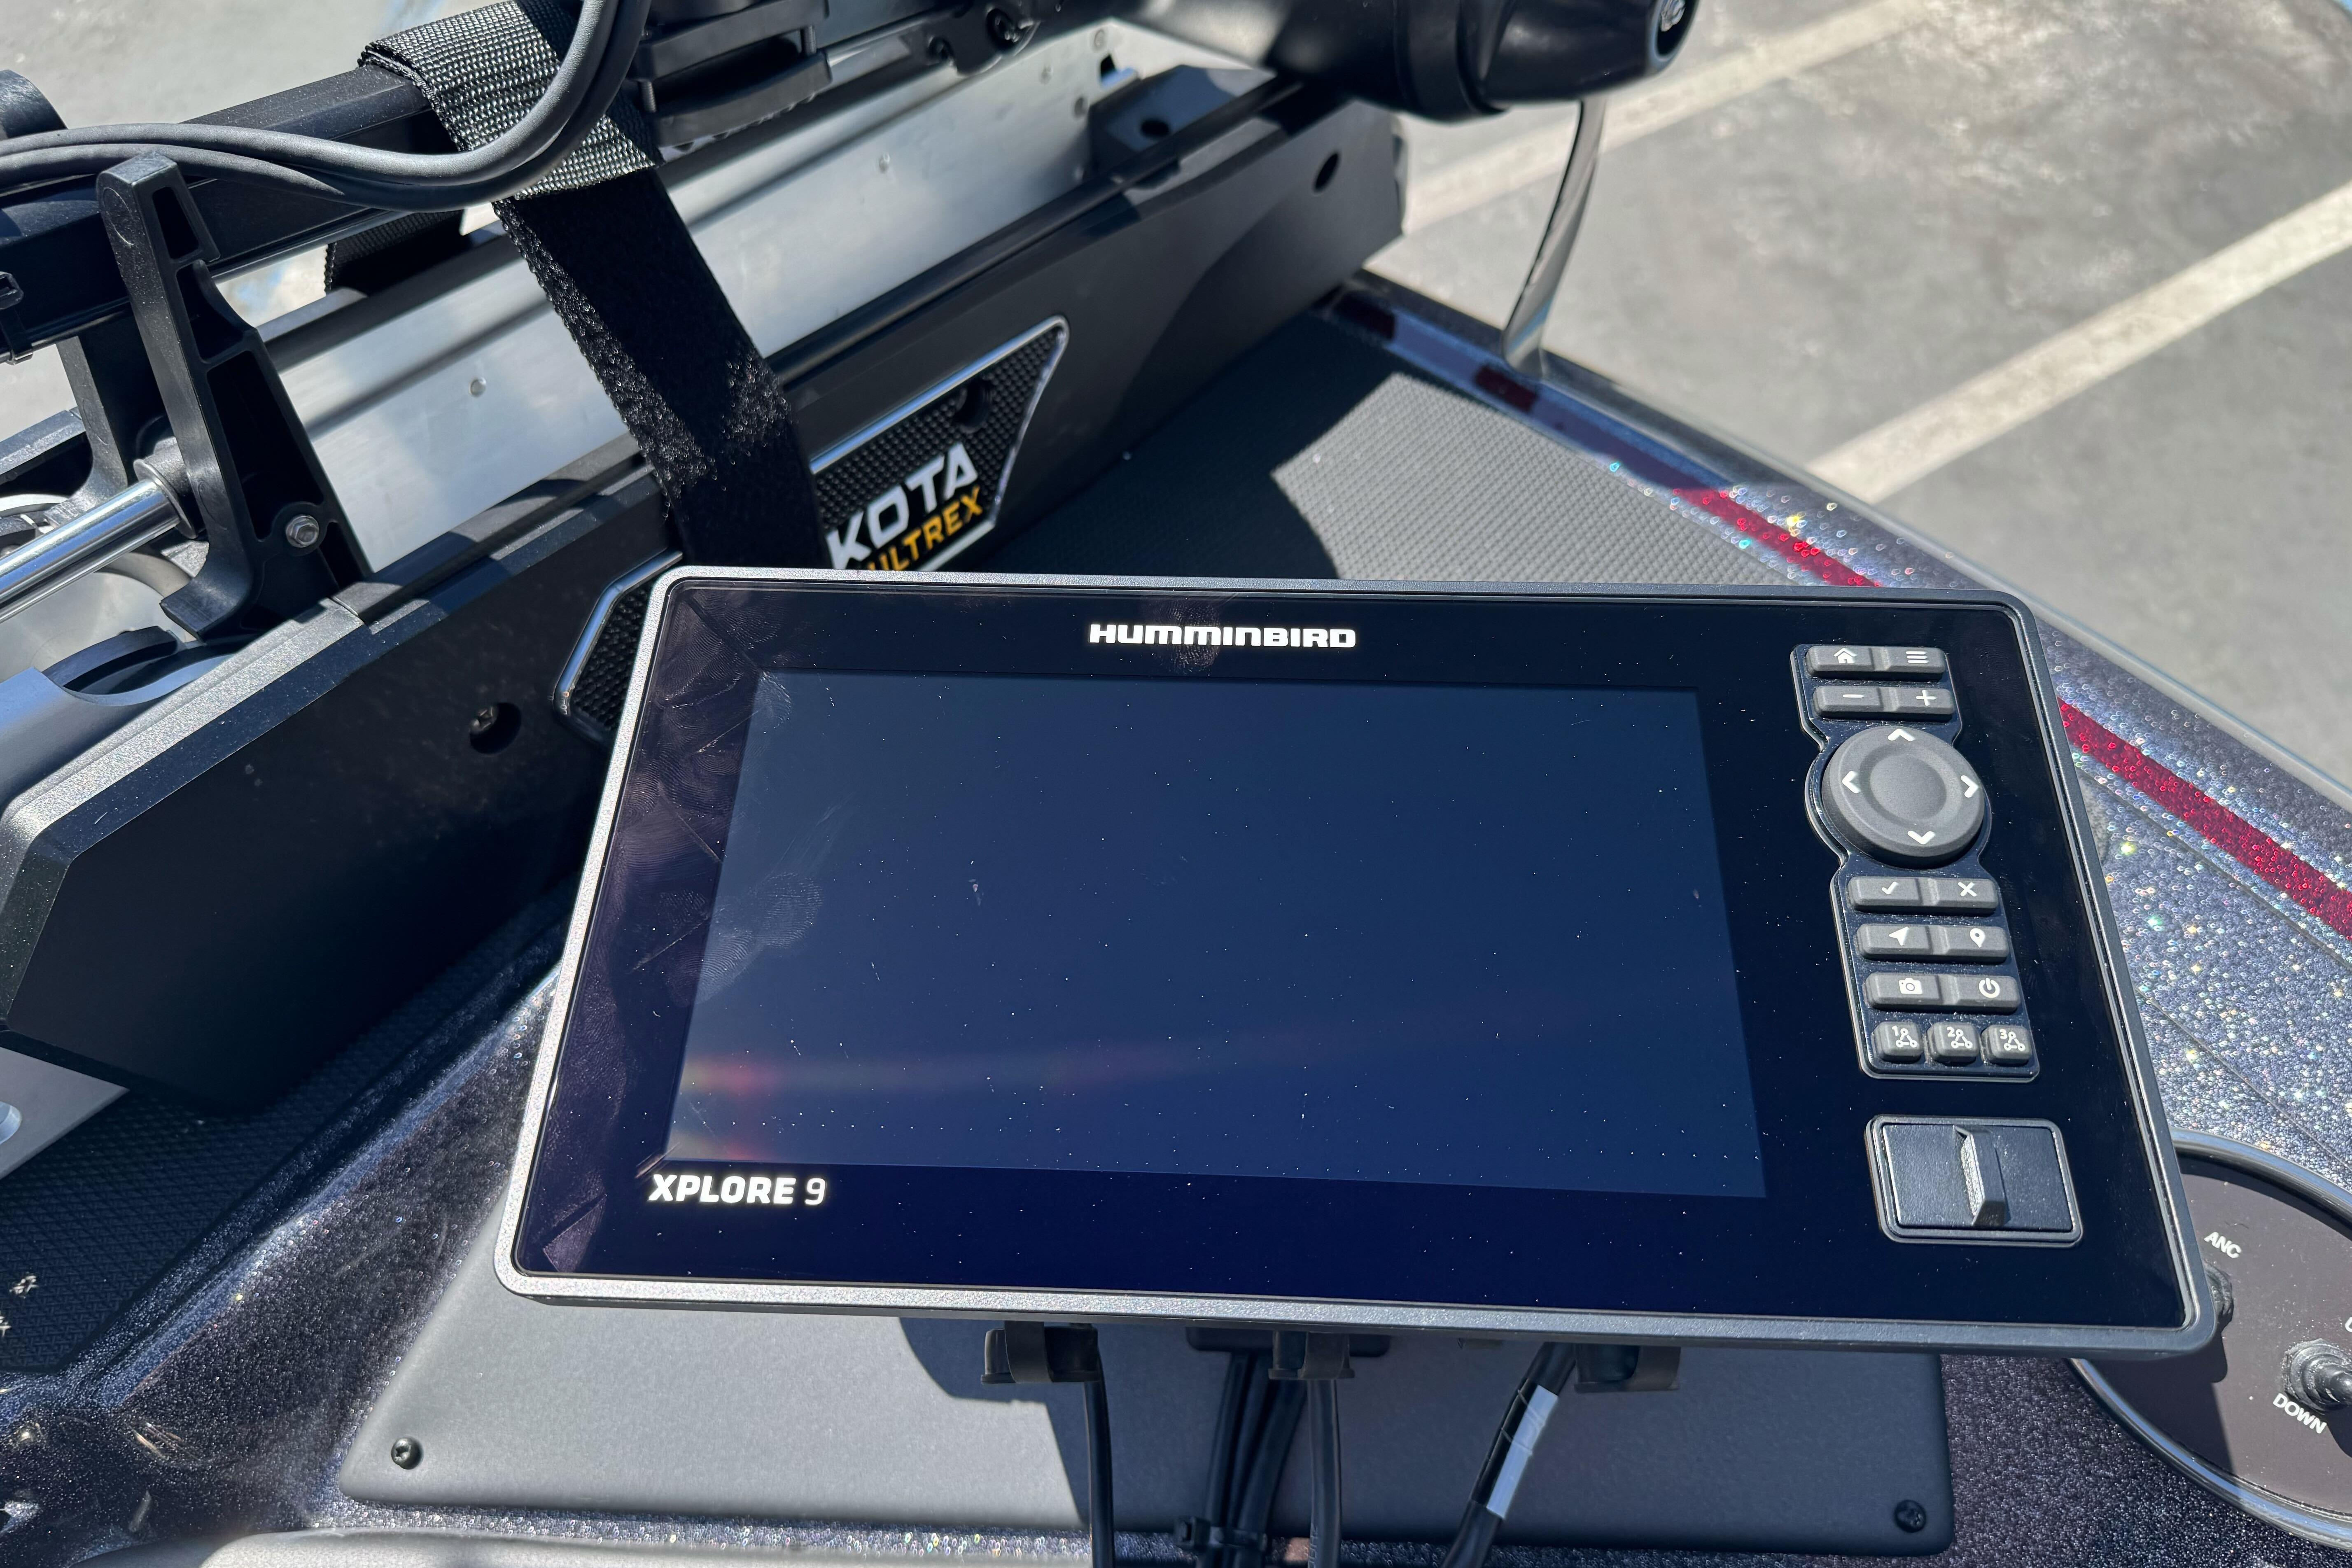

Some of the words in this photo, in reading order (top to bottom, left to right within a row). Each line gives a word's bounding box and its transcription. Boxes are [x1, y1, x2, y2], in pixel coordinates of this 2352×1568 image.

[826, 442, 978, 569] KOTA
[1089, 623, 1356, 649] HUMMINBIRD
[1892, 1025, 1899, 1036] 1
[1946, 1027, 1955, 1037] 2
[1999, 1029, 2008, 1039] 3
[648, 1174, 796, 1204] XPLORE
[804, 1177, 826, 1205] 9
[2204, 1232, 2242, 1258] ANC
[2273, 1393, 2327, 1434] DOWN
